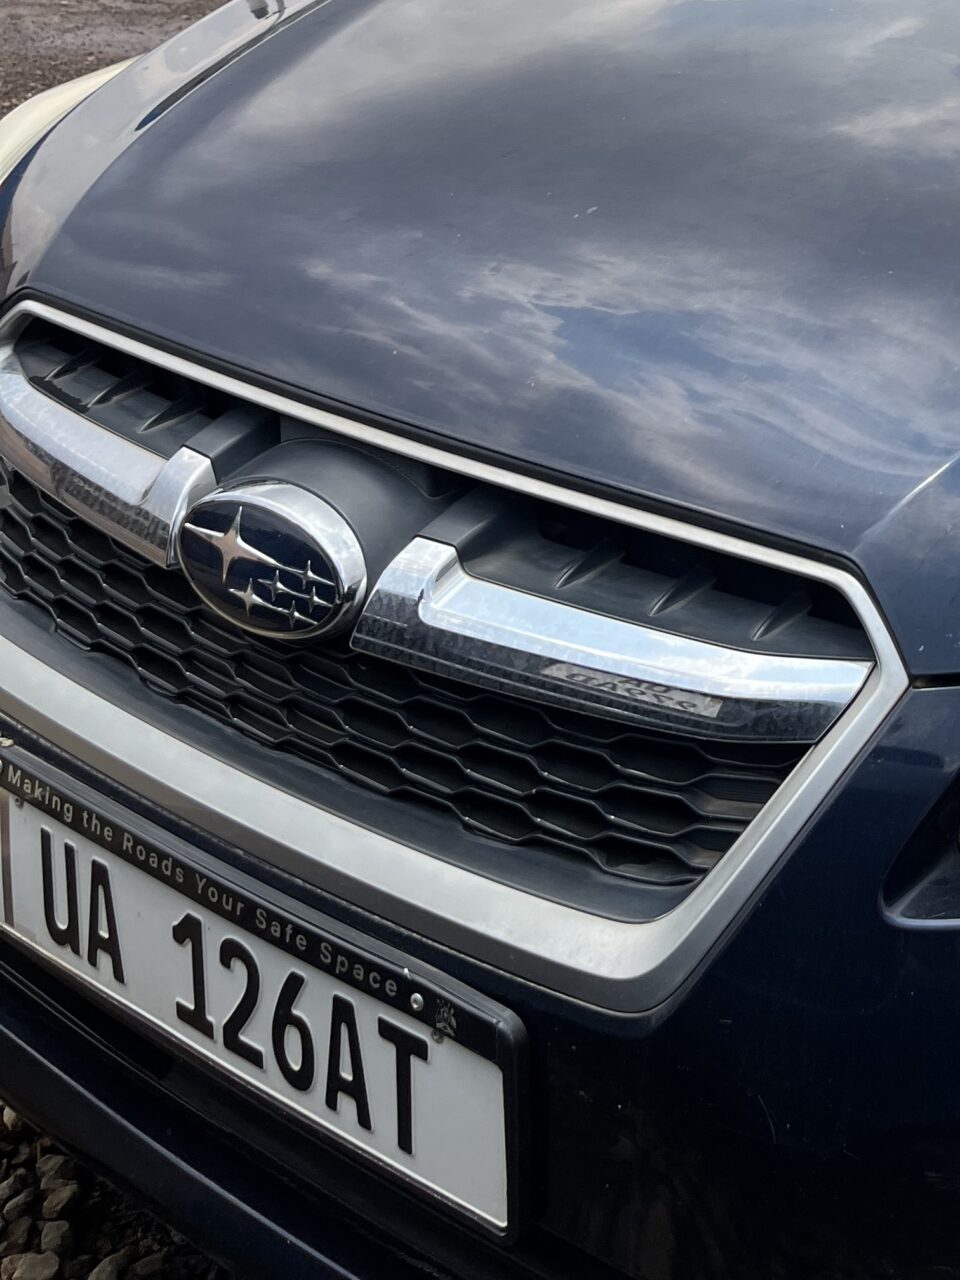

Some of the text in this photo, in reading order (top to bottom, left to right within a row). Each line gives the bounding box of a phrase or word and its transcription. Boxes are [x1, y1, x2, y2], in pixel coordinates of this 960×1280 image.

[7, 765, 398, 996] Making the Roads Your Safe Space
[40, 827, 429, 1156] UA 126AT
